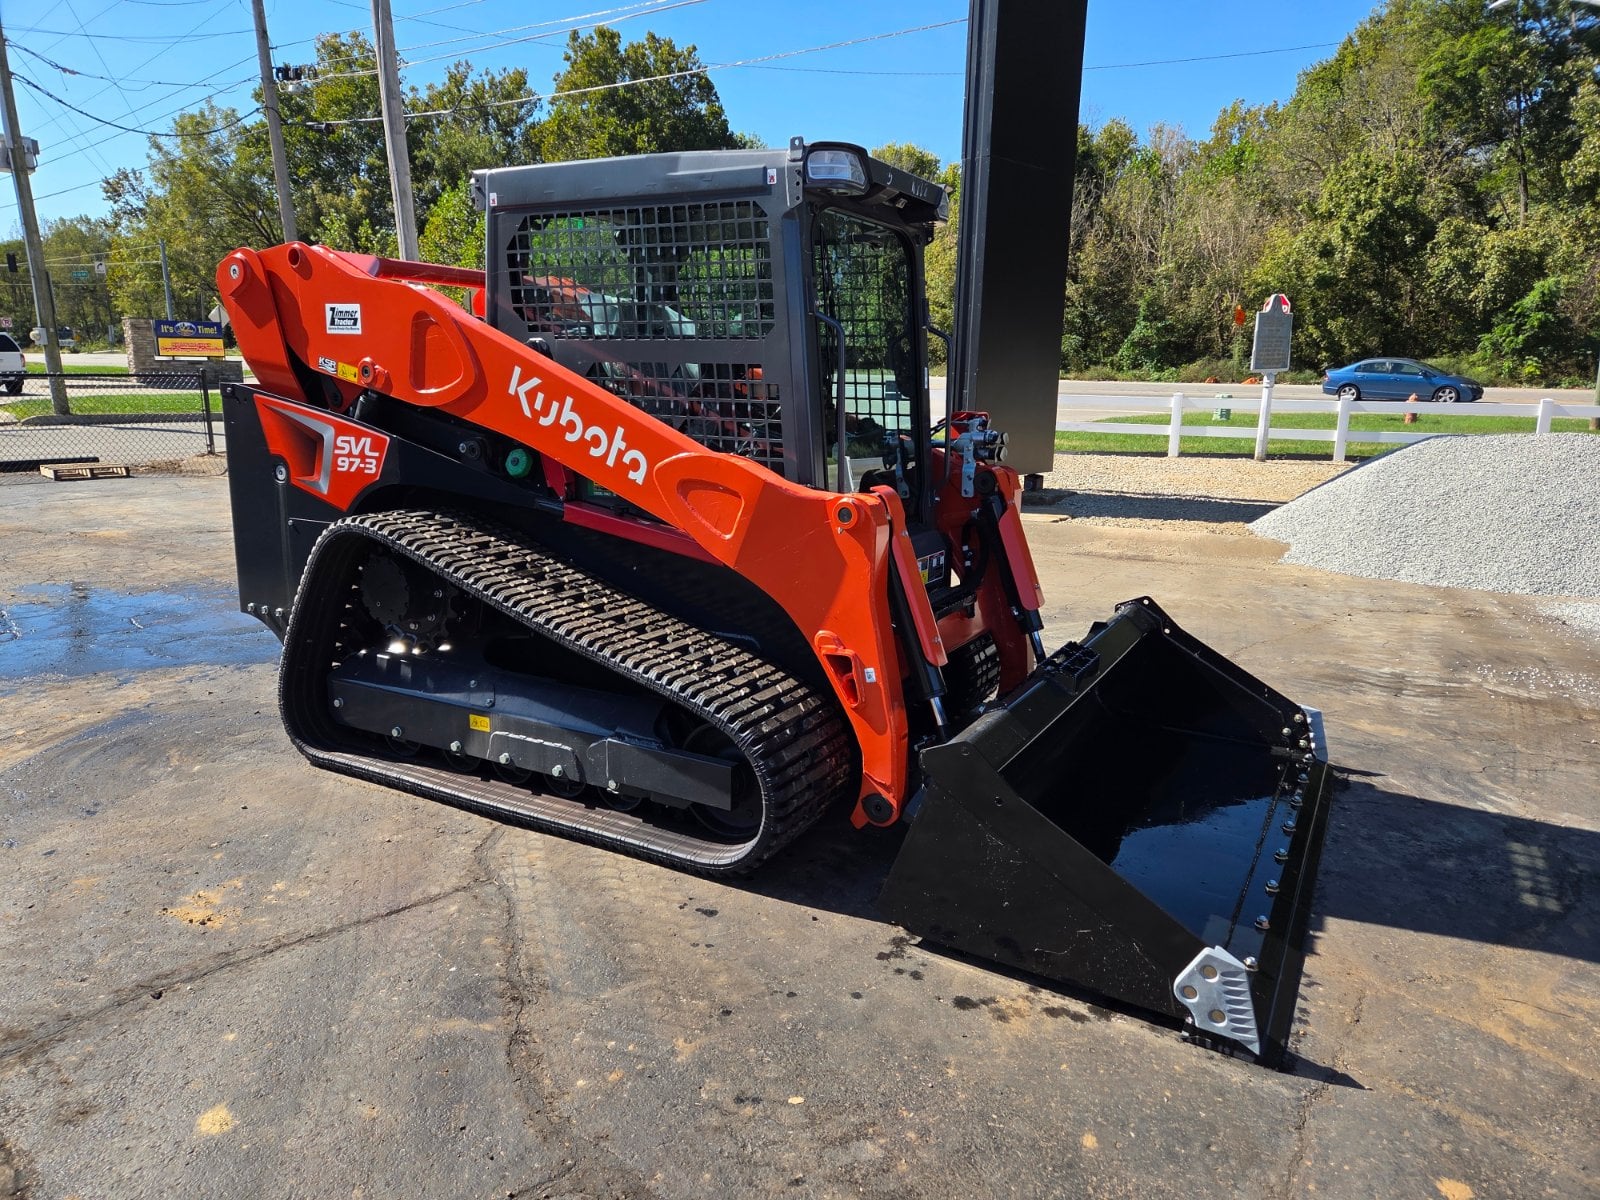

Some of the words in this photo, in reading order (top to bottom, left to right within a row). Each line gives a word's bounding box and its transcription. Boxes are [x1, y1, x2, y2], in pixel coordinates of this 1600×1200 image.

[329, 307, 358, 323] Zimmer
[160, 324, 174, 333] It's
[197, 325, 218, 334] Time!
[508, 365, 648, 485] Kubota
[334, 435, 380, 457] SVL
[337, 456, 377, 474] 97-3
